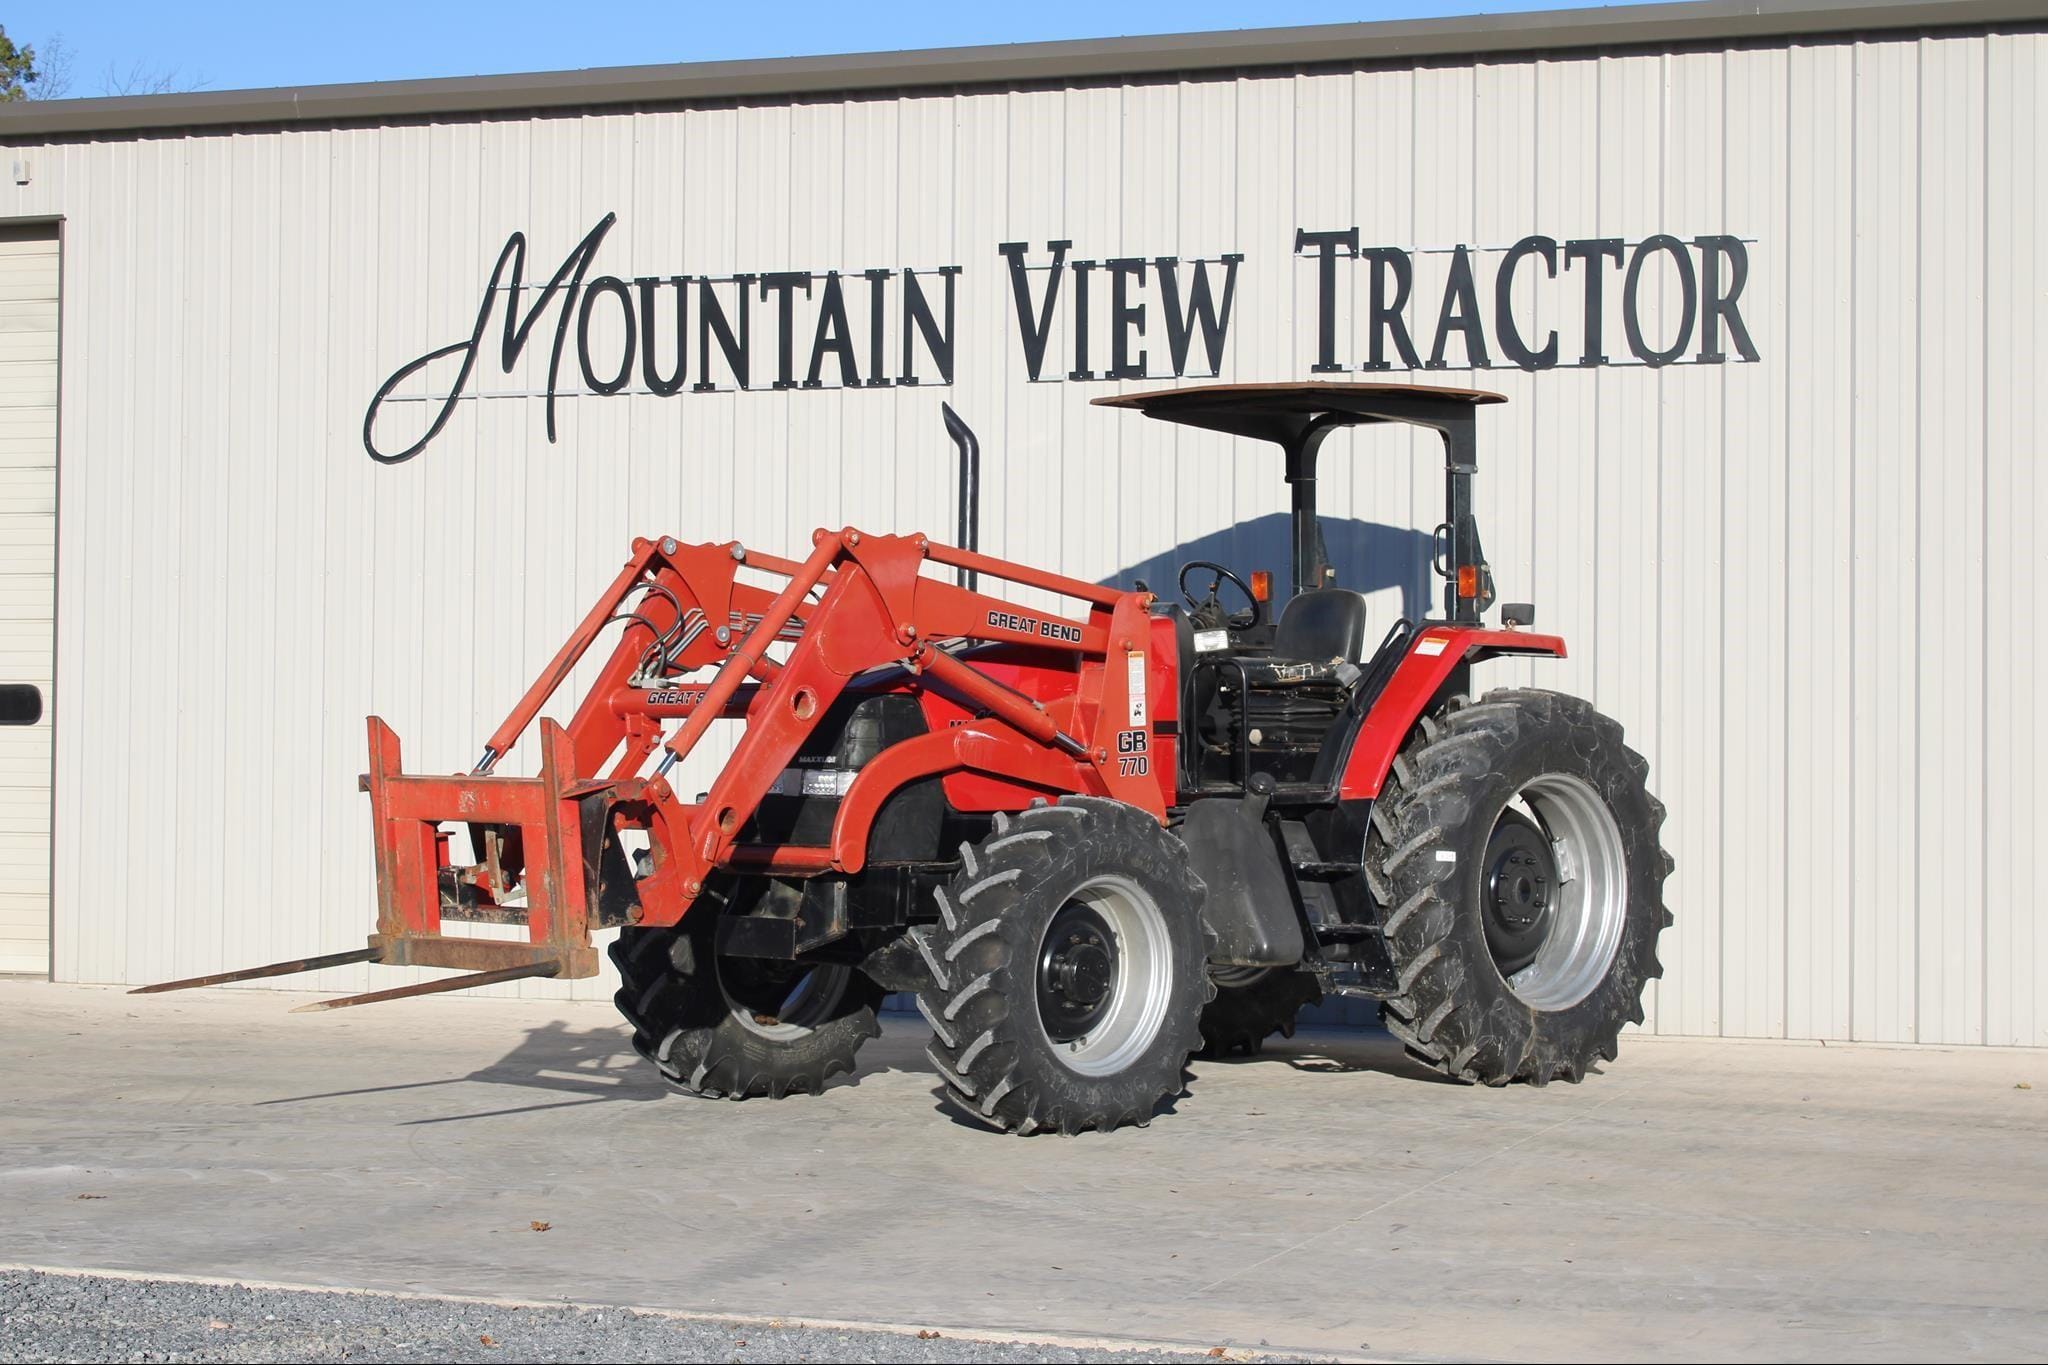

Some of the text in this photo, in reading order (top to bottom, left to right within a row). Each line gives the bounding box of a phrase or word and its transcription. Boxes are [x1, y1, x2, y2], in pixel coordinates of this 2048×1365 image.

[363, 212, 1760, 464] MOUNTAIN VIEW TRACTOR
[988, 611, 1081, 643] GREAT BEND
[648, 691, 696, 705] GREAT
[1118, 731, 1147, 753] GB
[1118, 756, 1147, 776] 770
